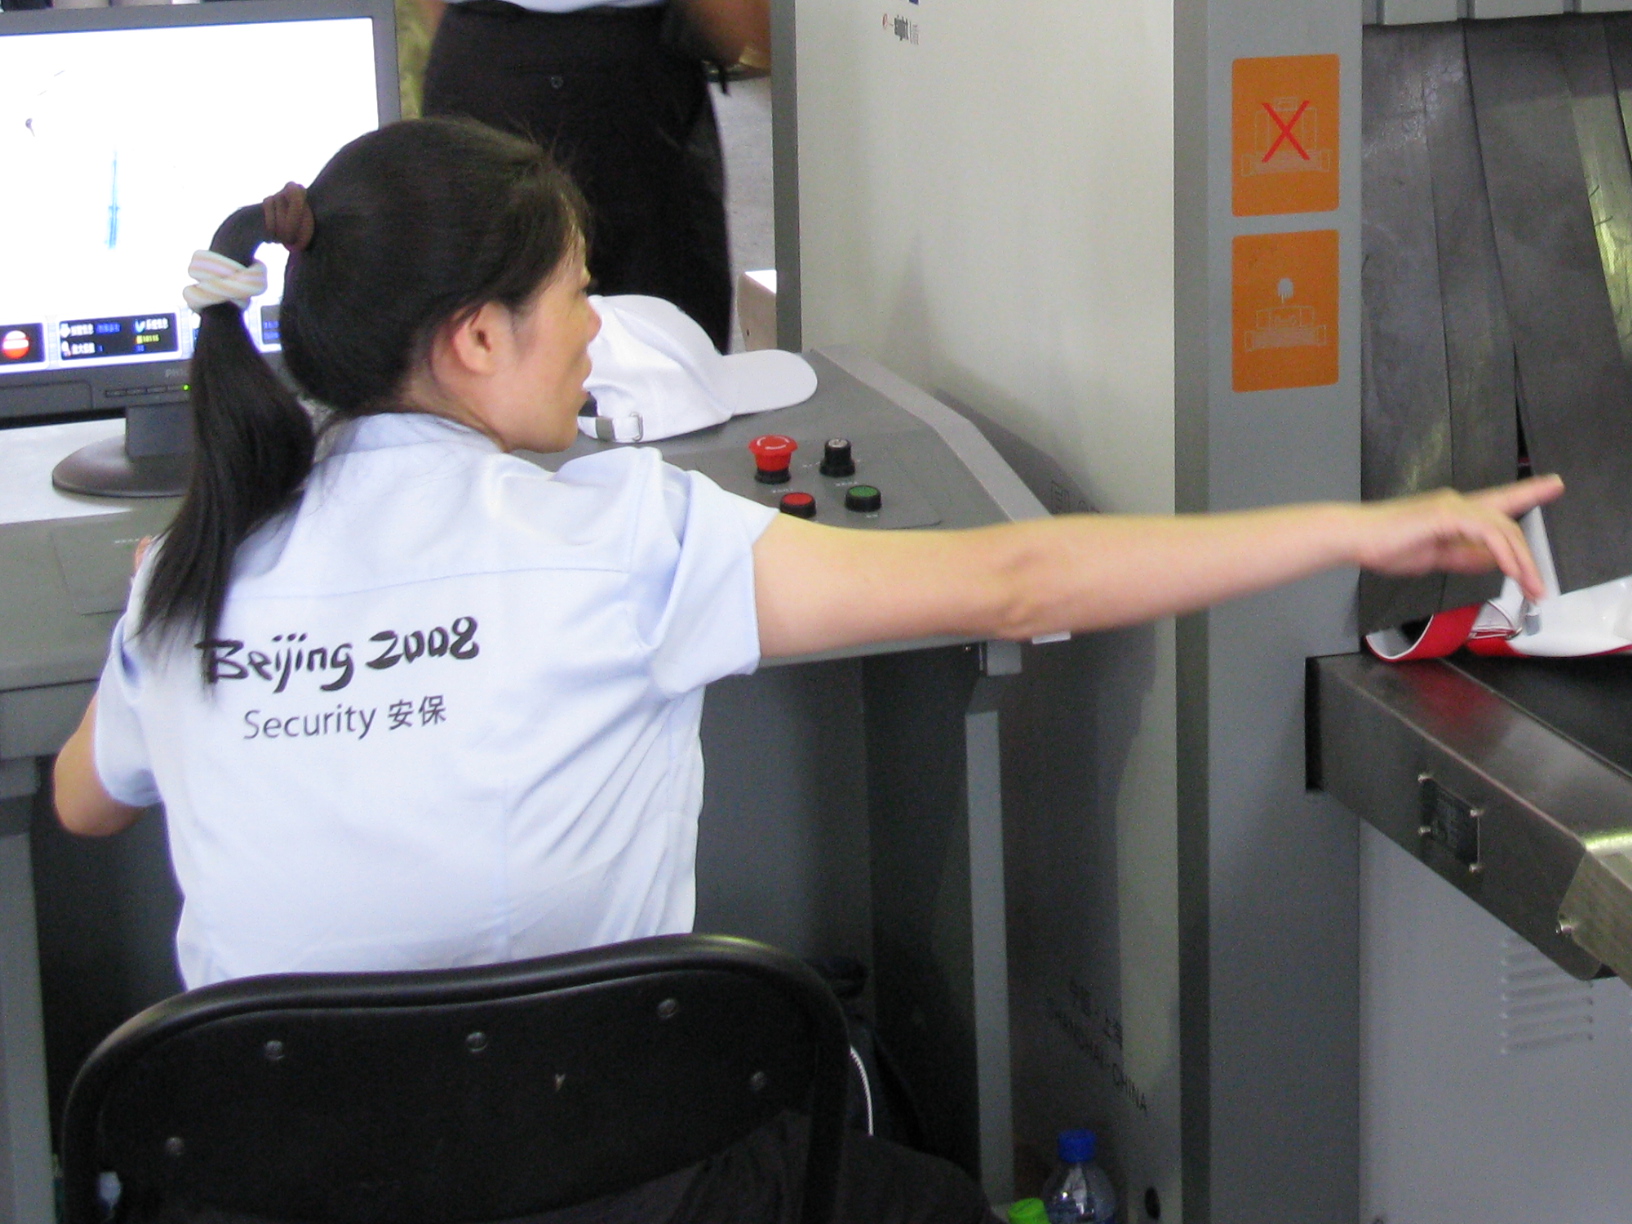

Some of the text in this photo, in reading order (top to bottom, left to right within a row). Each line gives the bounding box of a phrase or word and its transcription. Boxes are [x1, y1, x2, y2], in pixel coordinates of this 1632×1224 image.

[195, 616, 480, 693] Beijing 2008
[244, 694, 446, 740] Security 安保
